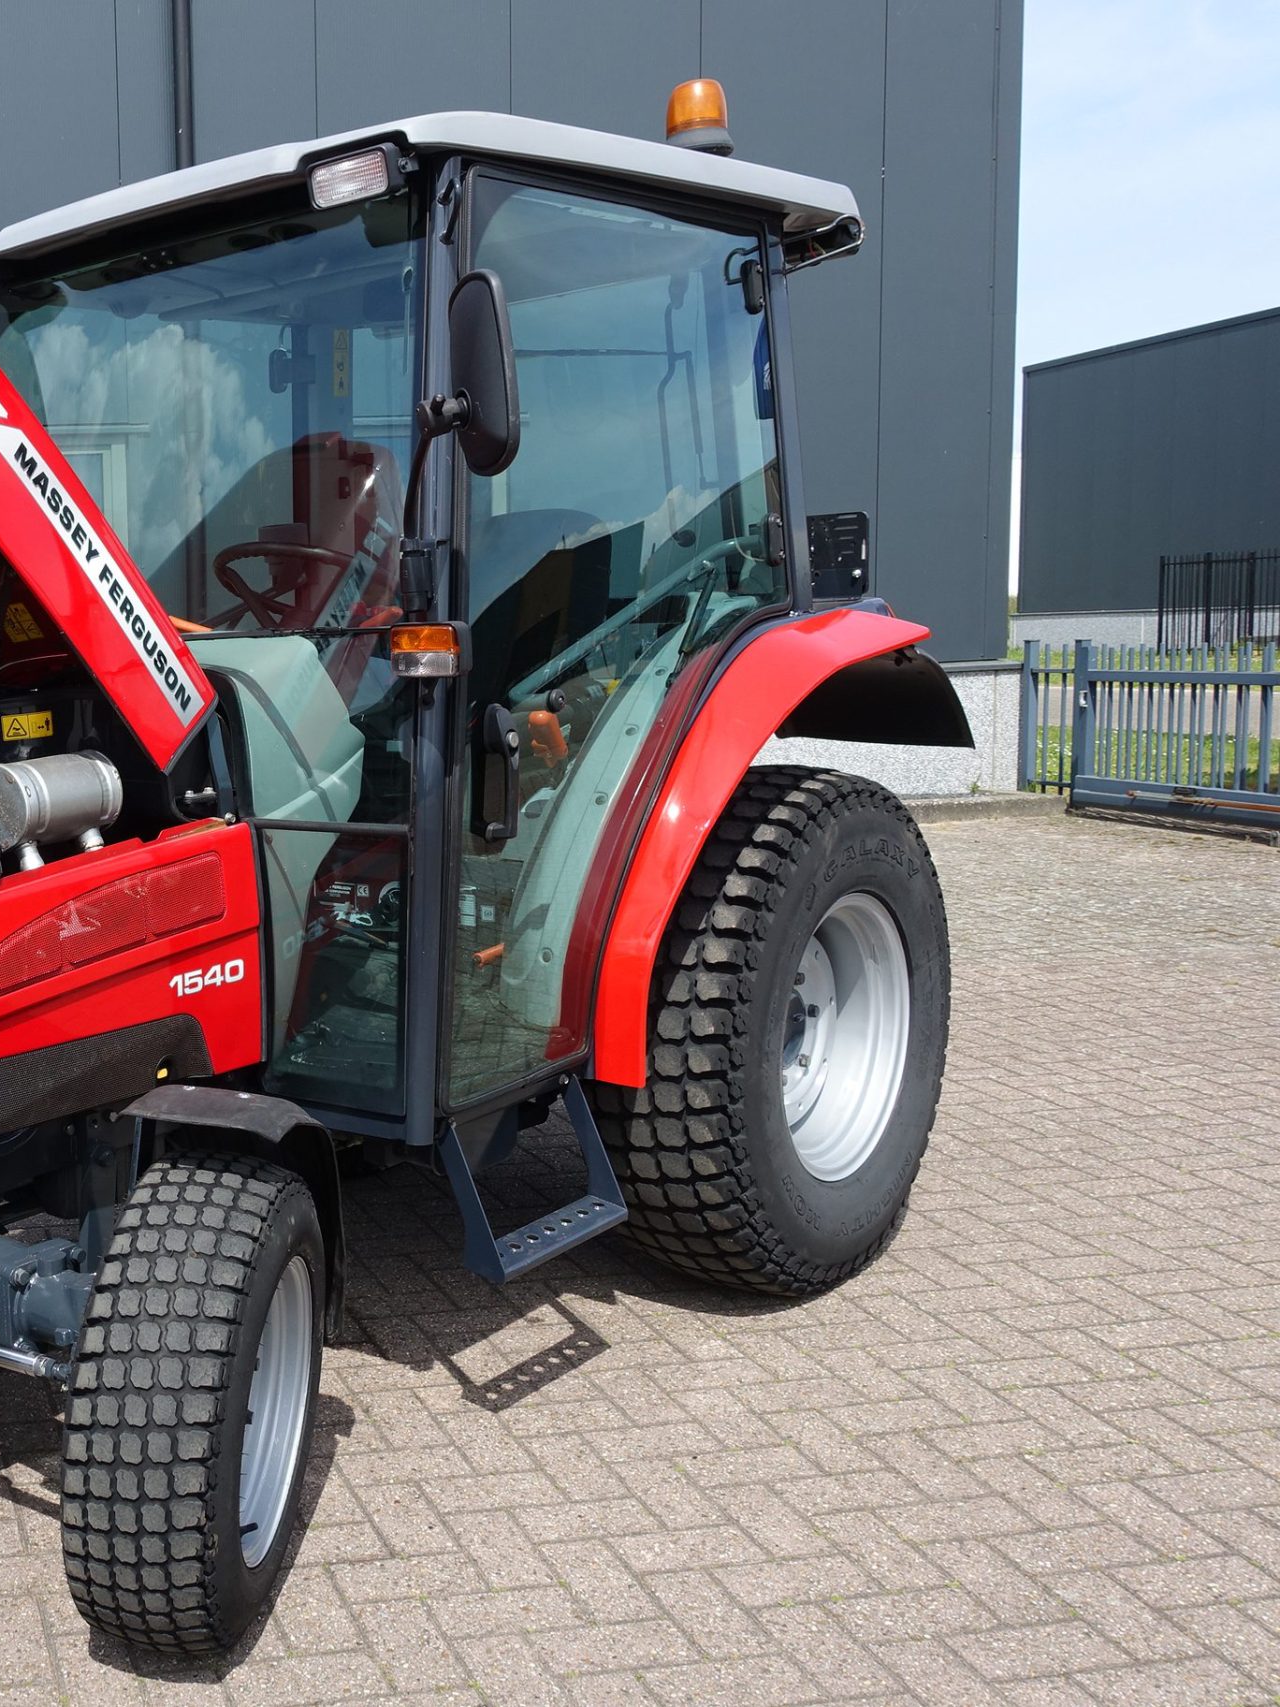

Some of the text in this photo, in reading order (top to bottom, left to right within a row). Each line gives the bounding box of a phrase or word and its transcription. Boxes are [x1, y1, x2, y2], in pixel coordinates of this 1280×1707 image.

[13, 442, 192, 713] MASSEY FERGUSON
[823, 838, 921, 883] GALAXY
[169, 958, 244, 997] 1540
